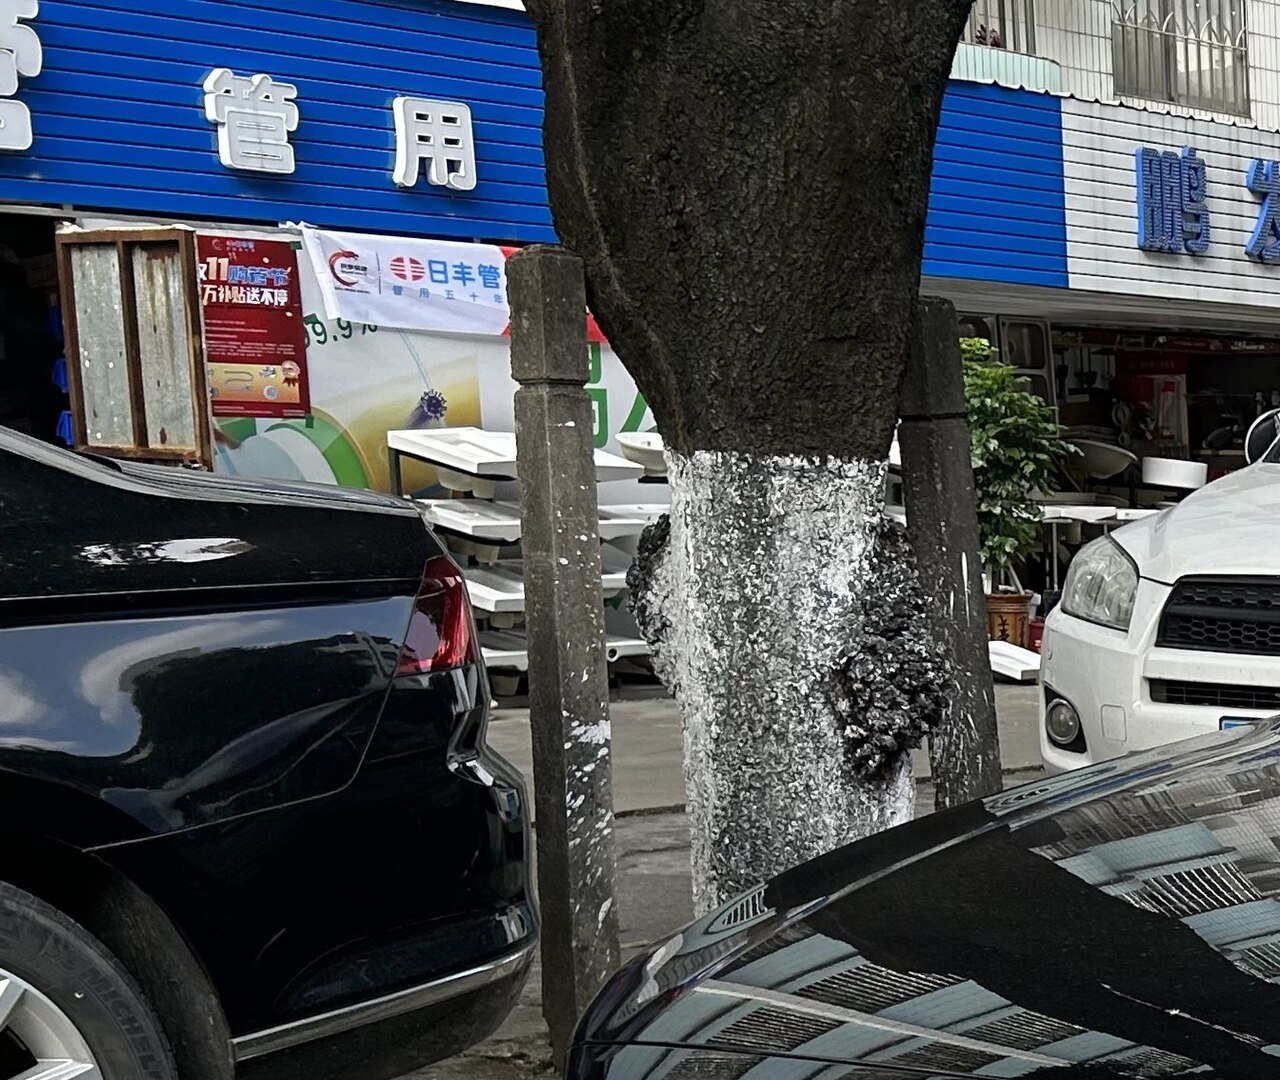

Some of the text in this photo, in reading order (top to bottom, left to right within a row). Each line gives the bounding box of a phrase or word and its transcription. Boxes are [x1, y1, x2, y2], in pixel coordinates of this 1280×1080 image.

[203, 67, 478, 191] 管用
[428, 259, 500, 289] 日丰管
[201, 284, 288, 306] 万补贴送不停
